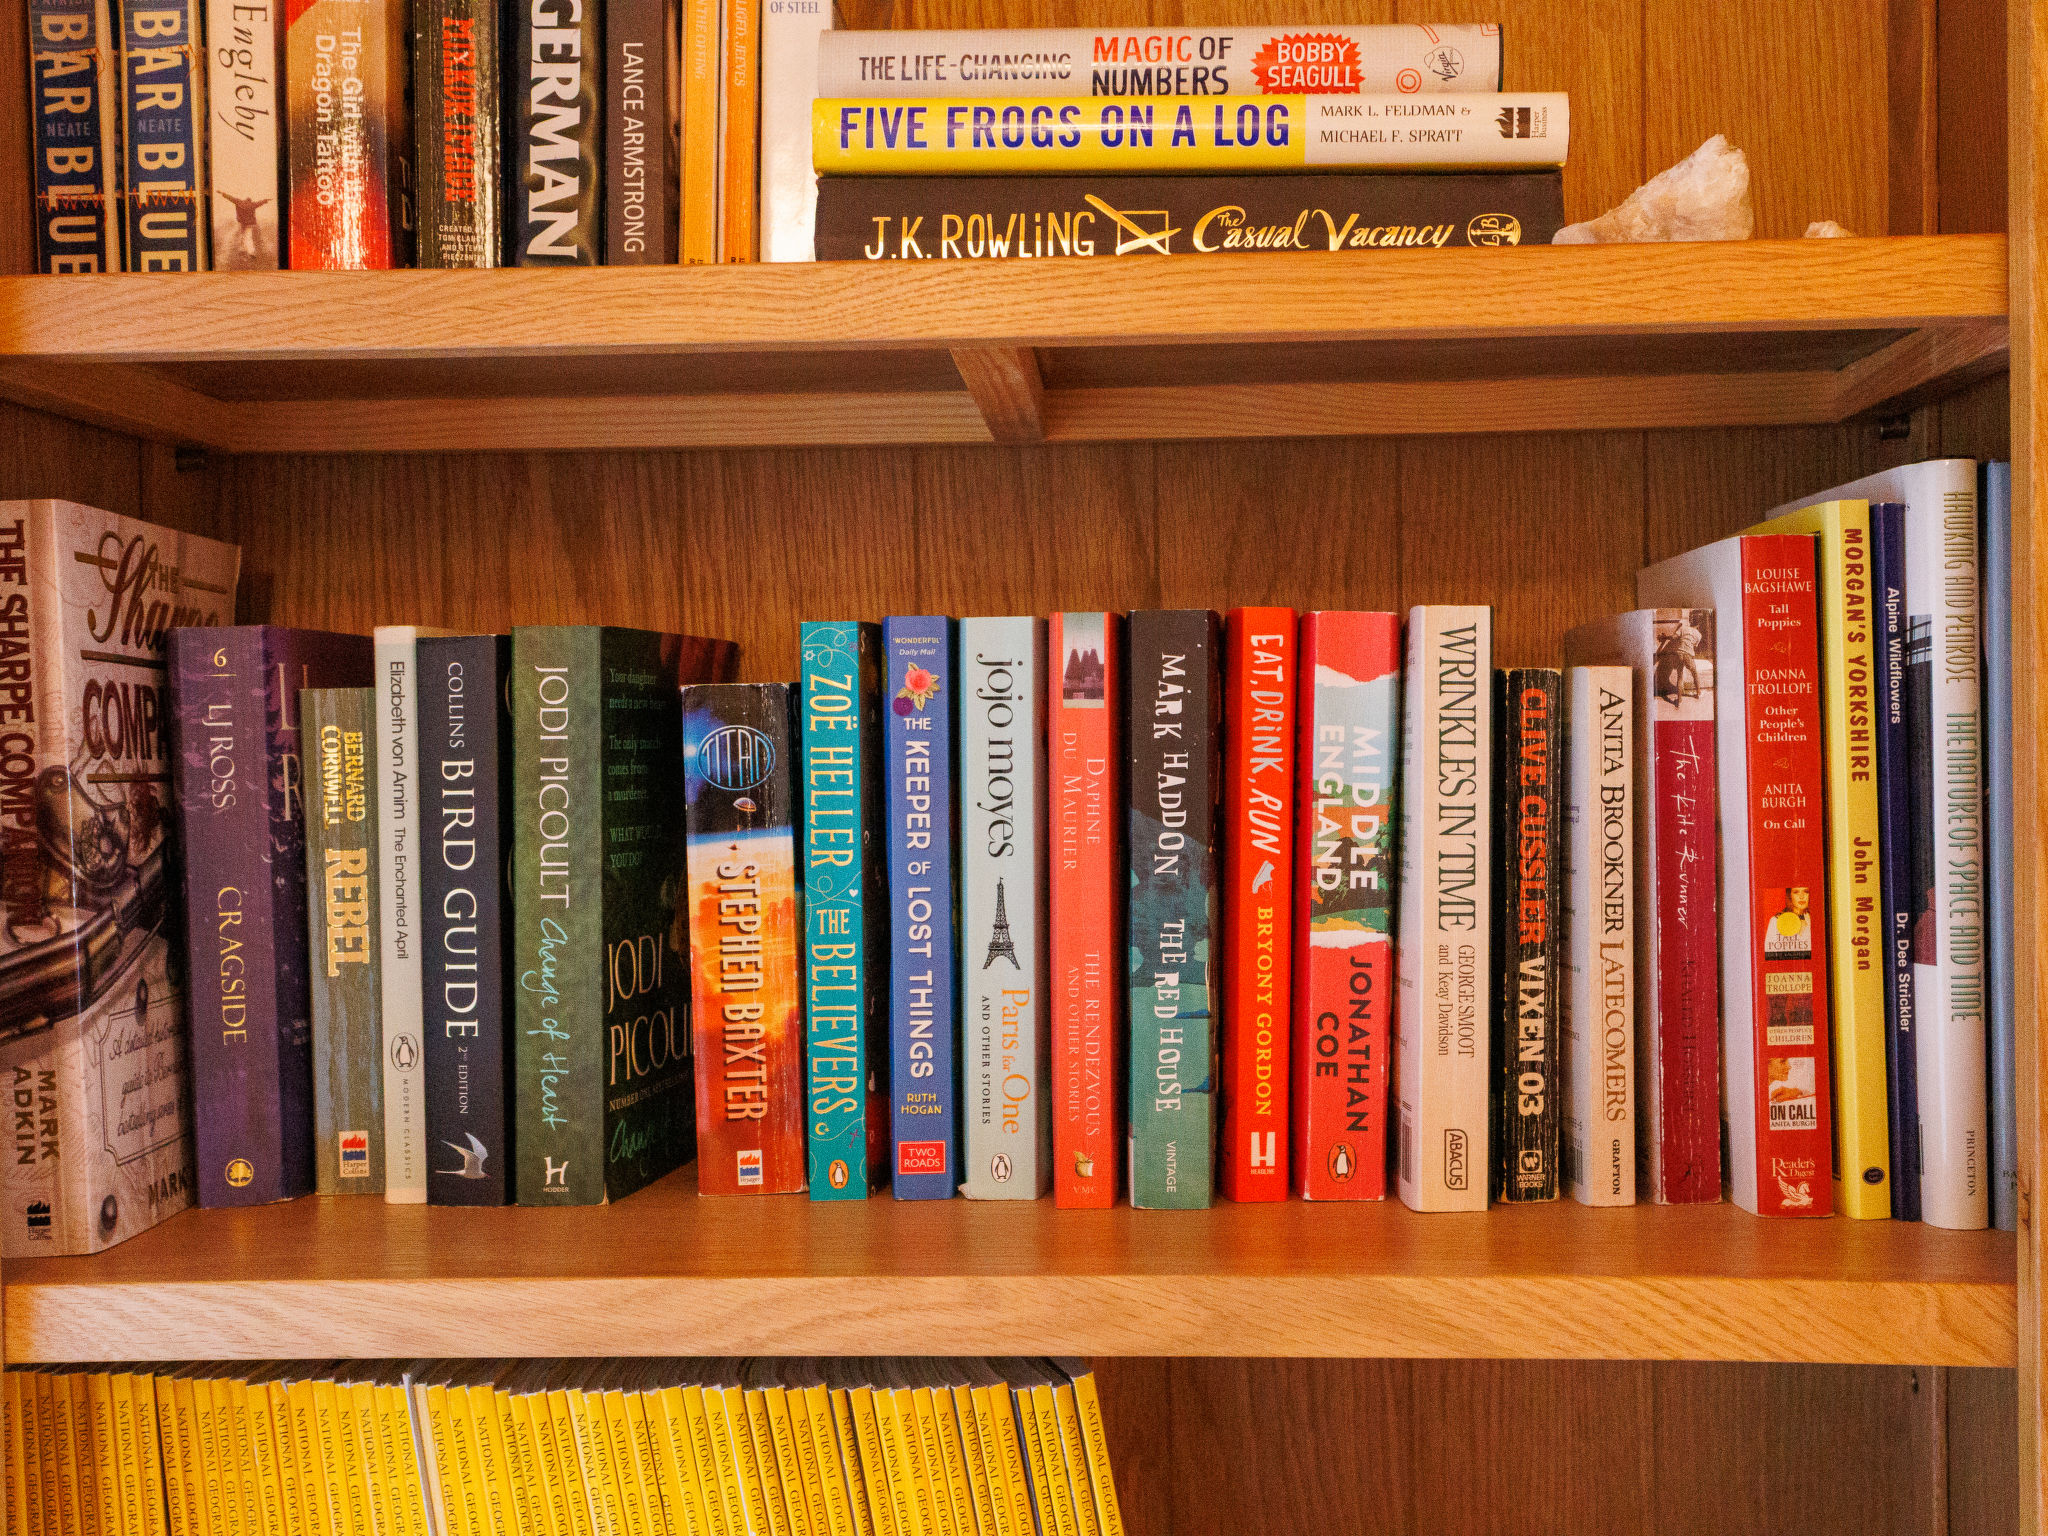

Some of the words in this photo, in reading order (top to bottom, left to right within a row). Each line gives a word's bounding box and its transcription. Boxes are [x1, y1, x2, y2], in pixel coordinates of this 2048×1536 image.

[770, 2, 784, 13] OF
[787, 1, 820, 14] STEEL
[40, 13, 92, 115] BAR
[132, 10, 184, 111] BAR
[219, 4, 270, 142] Engleby
[860, 57, 895, 81] THE
[901, 53, 1072, 81] LIFE-CHANGING
[1094, 36, 1192, 63] MAGIC
[1199, 37, 1233, 59] OF
[1277, 41, 1349, 64] BOBBY
[1432, 50, 1456, 82] Virgin
[312, 35, 336, 123] Dragon
[623, 42, 644, 110] LANCE
[1092, 66, 1227, 96] NUMBERS
[1268, 66, 1356, 87] SEAGULL
[47, 121, 91, 137] NEATE
[137, 118, 181, 133] NEATE
[840, 106, 927, 148] FIVE
[947, 105, 1081, 148] FROGS
[1101, 104, 1154, 147] ON
[1171, 104, 1197, 147] A
[1214, 104, 1289, 147] LOG
[1320, 104, 1362, 117] MARK
[1385, 104, 1455, 117] FELDMAN
[1320, 129, 1387, 143] MICHAEL
[1409, 129, 1463, 143] SPRATT
[1532, 110, 1540, 140] Harper
[1539, 106, 1548, 140] Business
[316, 131, 337, 206] Tattoo
[623, 117, 645, 252] ARMSTRONG
[1192, 206, 1309, 252] Casual
[1217, 211, 1238, 227] The
[1312, 209, 1454, 251] Vacancy
[1744, 581, 1812, 593] BAGSHAWE
[1756, 568, 1801, 579] LOUISE
[1844, 529, 1866, 643] MORGAN'S
[1758, 617, 1801, 630] Poppies
[1768, 604, 1789, 614] Tall
[1886, 587, 1900, 633] Alpine
[214, 648, 227, 667] 6
[1756, 669, 1806, 681] JOANNA
[1888, 639, 1902, 724] Wildflowers
[389, 661, 404, 734] Elizabeth
[448, 662, 465, 748] COLLINS
[535, 666, 569, 740] JODI
[809, 674, 858, 731] ZOË
[976, 653, 1023, 728] jojo
[1154, 651, 1186, 739] MARK
[1438, 622, 1477, 798] WRINKLES
[1749, 682, 1813, 694] TROLLOPE
[1765, 706, 1798, 716] Other
[904, 718, 932, 731] THE
[1520, 688, 1547, 786] CLIVE
[1599, 687, 1626, 776] ANITA
[1758, 732, 1807, 742] Children
[1759, 718, 1804, 731] People's
[1848, 654, 1869, 782] YORKSHIRE
[209, 737, 236, 809] ROSS
[343, 732, 366, 822] BERNARD
[392, 738, 404, 767] von
[392, 772, 407, 819] Arnim
[441, 758, 476, 870] BIRD
[810, 746, 854, 868] HELLER
[905, 741, 931, 849] KEEPER
[976, 738, 1014, 858] moyes
[1154, 752, 1189, 876] HADDON
[1316, 725, 1344, 891] ENGLAND
[1350, 726, 1381, 890] MIDDLE
[1761, 796, 1806, 808] BURGH
[1764, 784, 1803, 795] ANITA
[394, 827, 405, 852] The
[539, 758, 570, 908] PICOULT
[1438, 803, 1476, 839] IN
[1763, 820, 1779, 829] On
[1784, 819, 1805, 829] Call
[907, 861, 931, 874] OF
[1519, 795, 1546, 944] CUSSLER
[1600, 784, 1626, 935] BROOKNER
[1853, 837, 1873, 884] John
[325, 848, 369, 977] REBEL
[394, 854, 408, 927] Enchanted
[1438, 843, 1476, 932] TIME
[395, 931, 409, 959] April
[816, 909, 850, 934] THE
[907, 888, 932, 958] LOST
[1159, 919, 1186, 964] THE
[1851, 897, 1874, 971] Morgan
[1896, 912, 1908, 933] Dr.
[218, 887, 247, 1046] CRAGSIDE
[443, 888, 479, 1038] GUIDE
[521, 917, 568, 1008] Change
[607, 933, 663, 1013] JODI
[1085, 950, 1100, 990] THE
[1258, 907, 1272, 1004] BRYONY
[1438, 944, 1450, 966] and
[1768, 973, 1811, 983] JOANNA
[1897, 940, 1909, 968] Dee
[982, 996, 991, 1020] AND
[1067, 967, 1078, 998] AND
[1154, 972, 1180, 1019] RED
[1436, 971, 1454, 1000] Keay
[1767, 982, 1811, 992] TROLLOPE
[1899, 972, 1910, 1032] Strickler
[527, 1018, 571, 1041] of
[811, 942, 858, 1114] BELIEVERS
[908, 970, 934, 1078] THINGS
[1001, 989, 1030, 1050] Paris
[1068, 1004, 1079, 1055] OTHER
[1438, 1004, 1454, 1056] Davidson
[1519, 956, 1545, 1062] VIXEN
[1599, 940, 1627, 1122] LATECOMERS
[722, 1004, 768, 1122] BAXTER
[982, 1026, 990, 1068] OTHER
[1002, 1056, 1016, 1072] for
[1085, 998, 1100, 1136] RENDEZVOUS
[1256, 1012, 1272, 1116] GORDON
[1316, 1012, 1340, 1077] COE
[1346, 956, 1372, 1132] JONATHAN
[460, 1065, 468, 1114] EDITION
[540, 1052, 569, 1130] Heart
[1068, 1061, 1079, 1122] STORIES
[1155, 1028, 1184, 1112] HOUSE
[1518, 1072, 1545, 1116] 03
[13, 1066, 36, 1165] ADKIN
[38, 1070, 61, 1161] MARK
[402, 1079, 410, 1123] MODERN
[901, 1105, 942, 1115] HOGAN
[907, 1093, 936, 1102] RUTH
[982, 1074, 990, 1125] STORIES
[1002, 1074, 1030, 1134] One
[1770, 1105, 1786, 1120] ON
[1789, 1104, 1816, 1120] CALL
[404, 1128, 412, 1180] CLASSICS
[904, 1157, 940, 1168] ROADS
[908, 1148, 936, 1157] TWO
[1166, 1141, 1176, 1192] VINTAGE
[1449, 1134, 1463, 1186] ABACUS
[1612, 1139, 1620, 1195] GRAFTON
[1772, 1158, 1815, 1177] Reader's
[1967, 1130, 1976, 1196] PRINCETON
[118, 1400, 134, 1470] NATIONAL
[319, 1409, 337, 1477] NATIONAL
[1086, 1400, 1107, 1469] NATIONAL
